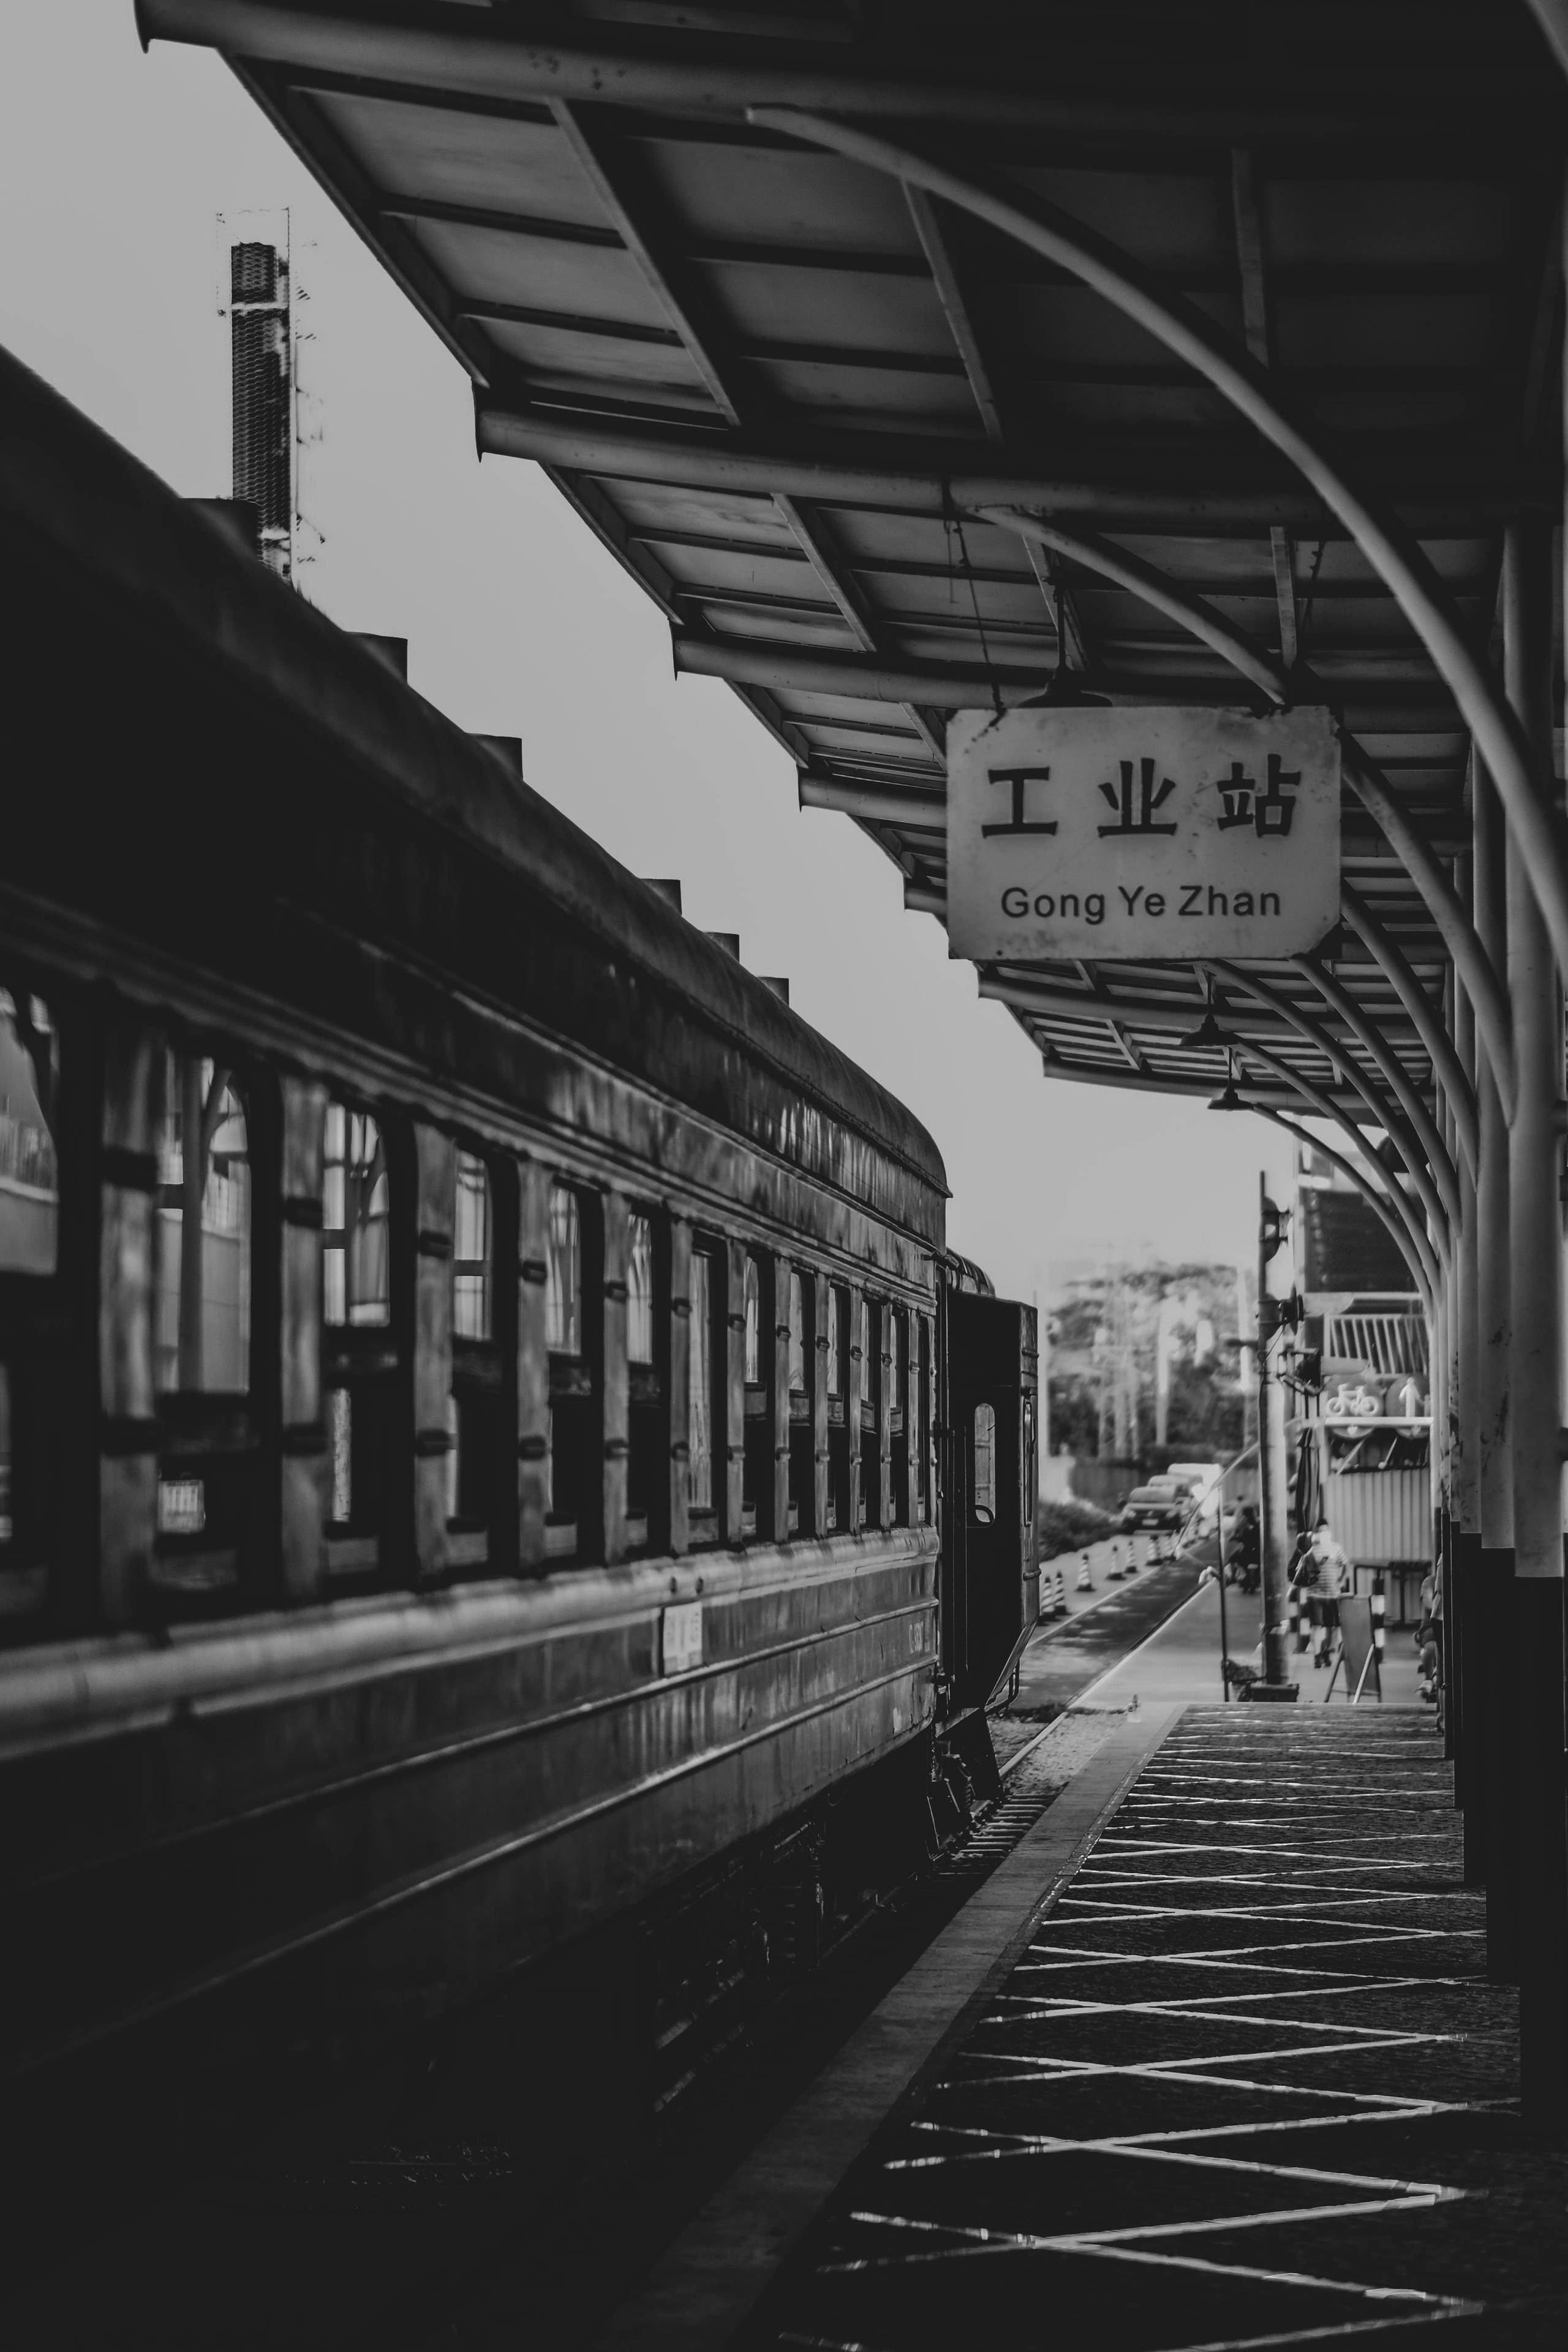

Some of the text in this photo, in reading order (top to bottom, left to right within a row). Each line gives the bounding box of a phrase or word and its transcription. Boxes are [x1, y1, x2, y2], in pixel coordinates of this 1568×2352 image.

[981, 753, 1302, 839] 工业站
[1001, 886, 1280, 924] Gong Ye Zhan
